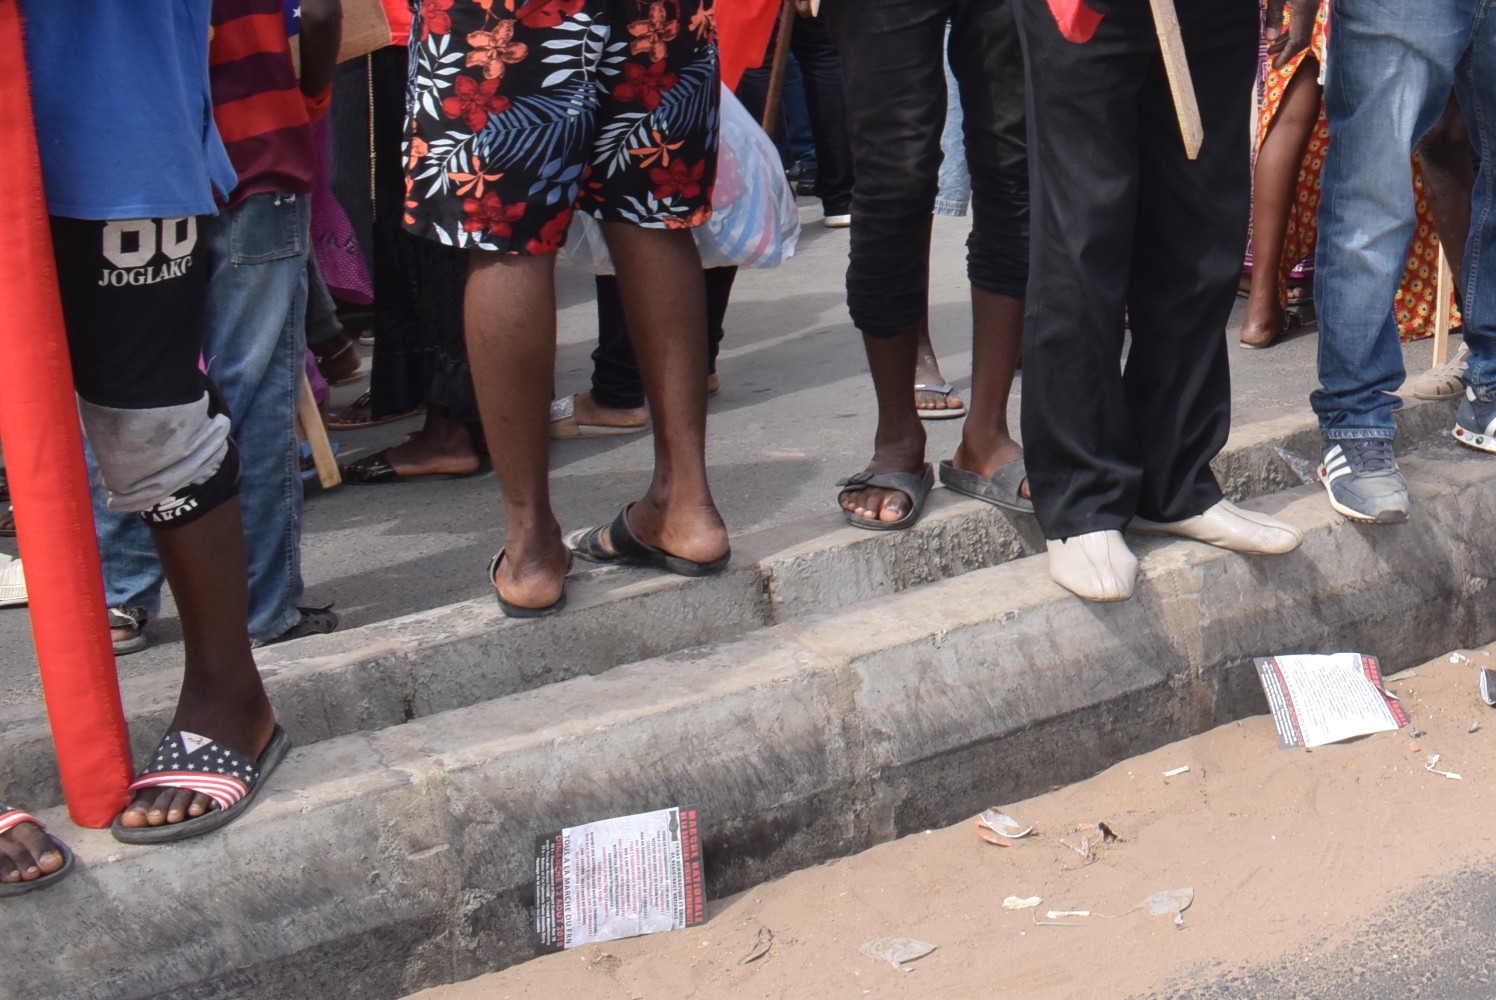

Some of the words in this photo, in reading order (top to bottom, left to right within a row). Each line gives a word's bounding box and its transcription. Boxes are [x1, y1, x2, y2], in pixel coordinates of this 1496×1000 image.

[563, 835, 571, 855] TOUS
[689, 810, 700, 858] MARCHE
[554, 836, 563, 883] DIMANCHE
[563, 865, 571, 875] LA
[691, 861, 703, 923] NATIONALE
[566, 914, 572, 927] DU
